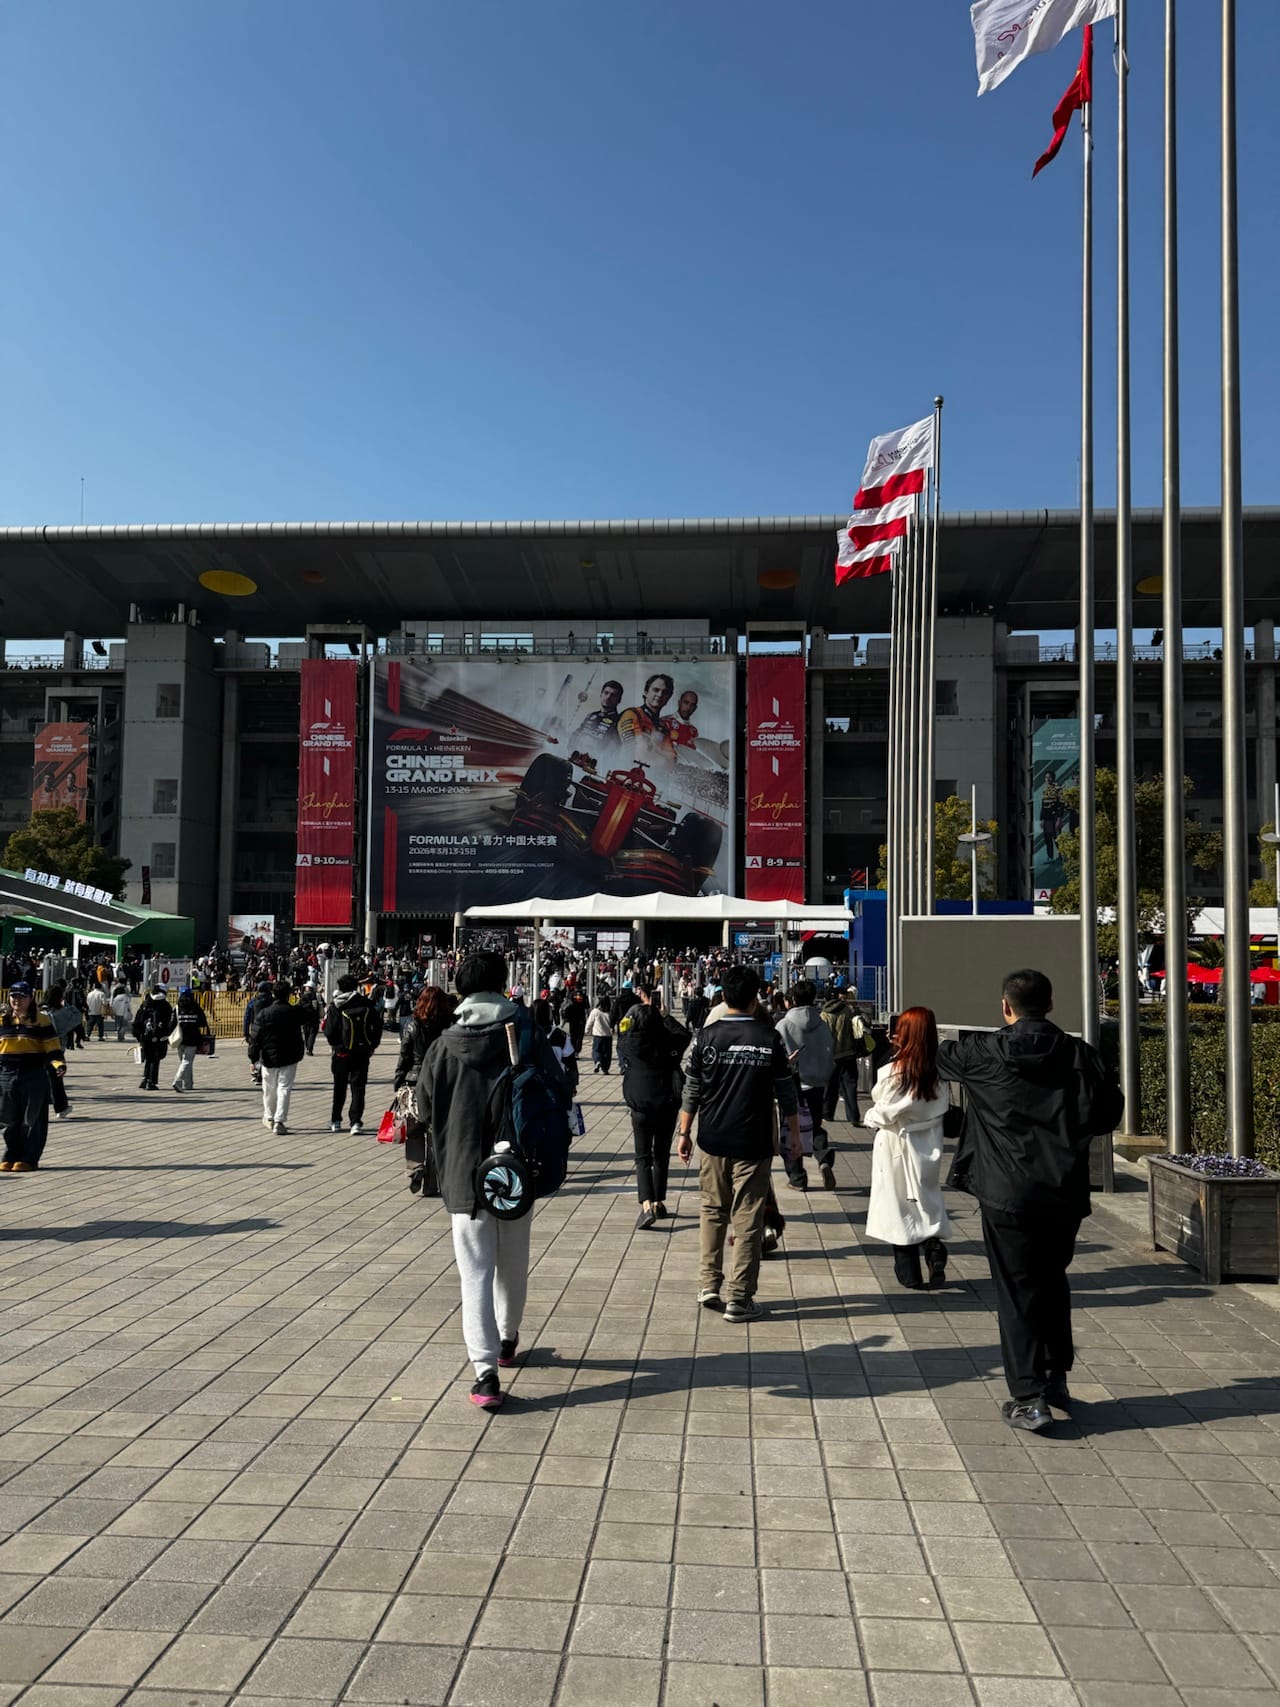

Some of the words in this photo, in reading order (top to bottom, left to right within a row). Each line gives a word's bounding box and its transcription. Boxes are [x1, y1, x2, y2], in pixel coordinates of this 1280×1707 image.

[758, 733, 794, 741] CHINESE
[433, 744, 472, 752] HEINEKEN
[385, 755, 464, 768] CHINESE
[385, 769, 453, 782] GRAND
[455, 769, 500, 782] PRIX
[447, 786, 471, 794] 2026
[303, 792, 351, 818] Shanghai
[750, 792, 801, 819] Shanghai
[409, 835, 470, 845] FORMULA
[408, 847, 477, 855] 2026年3月13-15日
[300, 856, 310, 865] A
[313, 856, 336, 865] 9-10
[750, 857, 760, 867] A
[766, 858, 784, 866] 8-9
[1039, 890, 1049, 899] A
[742, 1046, 772, 1055] AMG
